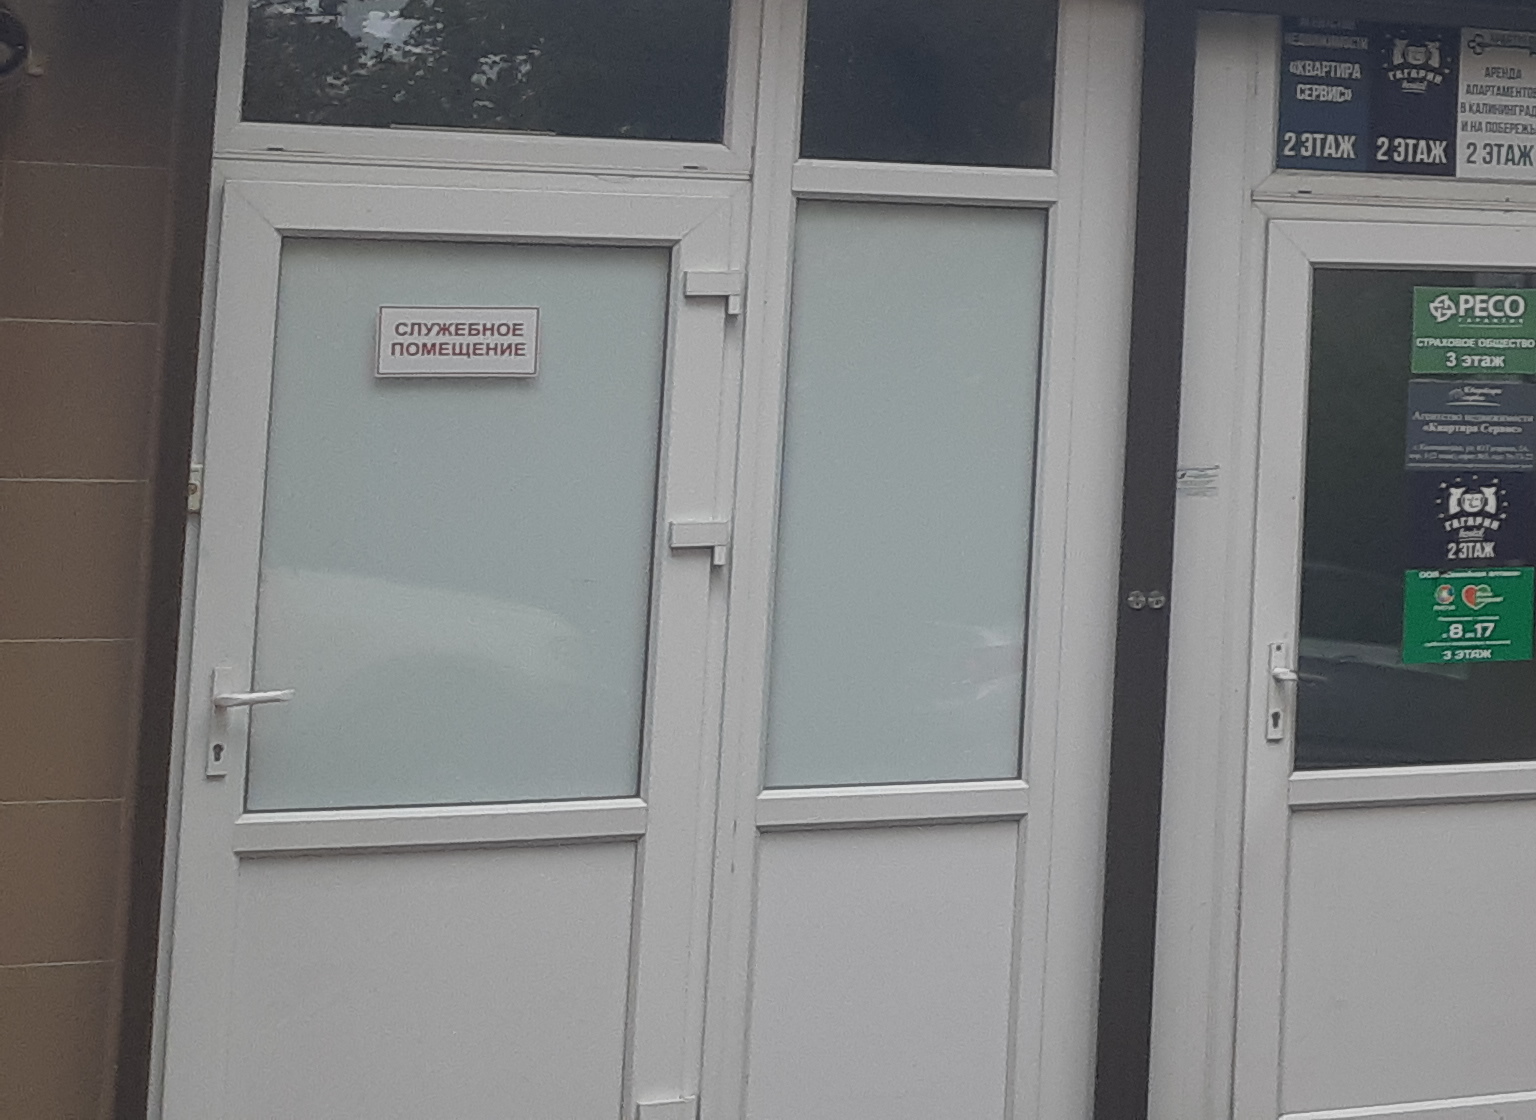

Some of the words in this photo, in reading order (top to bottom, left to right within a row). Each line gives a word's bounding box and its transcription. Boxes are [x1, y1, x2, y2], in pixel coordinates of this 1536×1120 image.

[1289, 60, 1361, 79] «КВАРТИРА
[1484, 66, 1522, 80] АРЕНДА
[1296, 83, 1352, 102] СЕРВИС»
[1460, 102, 1467, 114] В
[1461, 121, 1469, 133] И
[1470, 121, 1483, 133] НА
[1283, 132, 1296, 156] 2
[1300, 133, 1357, 159] ЭТАЖ
[1376, 137, 1389, 161] 2
[1393, 138, 1448, 164] ЭТАЖ
[1466, 142, 1478, 164] 2
[1482, 142, 1534, 167] ЭТАЖ
[1458, 294, 1525, 317] РЕСО
[394, 322, 525, 337] СЛУЖЕБНОЕ
[390, 342, 527, 358] ПОМЕЩЕНИЕ
[1415, 337, 1476, 348] СТРАХОВОЕ
[1477, 338, 1536, 348] ОБЩЕСТВО
[1445, 351, 1457, 367] 3
[1461, 354, 1505, 368] этаж
[1444, 516, 1500, 531] ГАГАРИН
[1447, 543, 1457, 559] 2
[1458, 541, 1496, 559] ЭТАЖ
[1449, 623, 1463, 639] 8
[1474, 622, 1495, 638] 17
[1441, 650, 1451, 660] 3
[1454, 649, 1493, 660] ЭТАЖ
